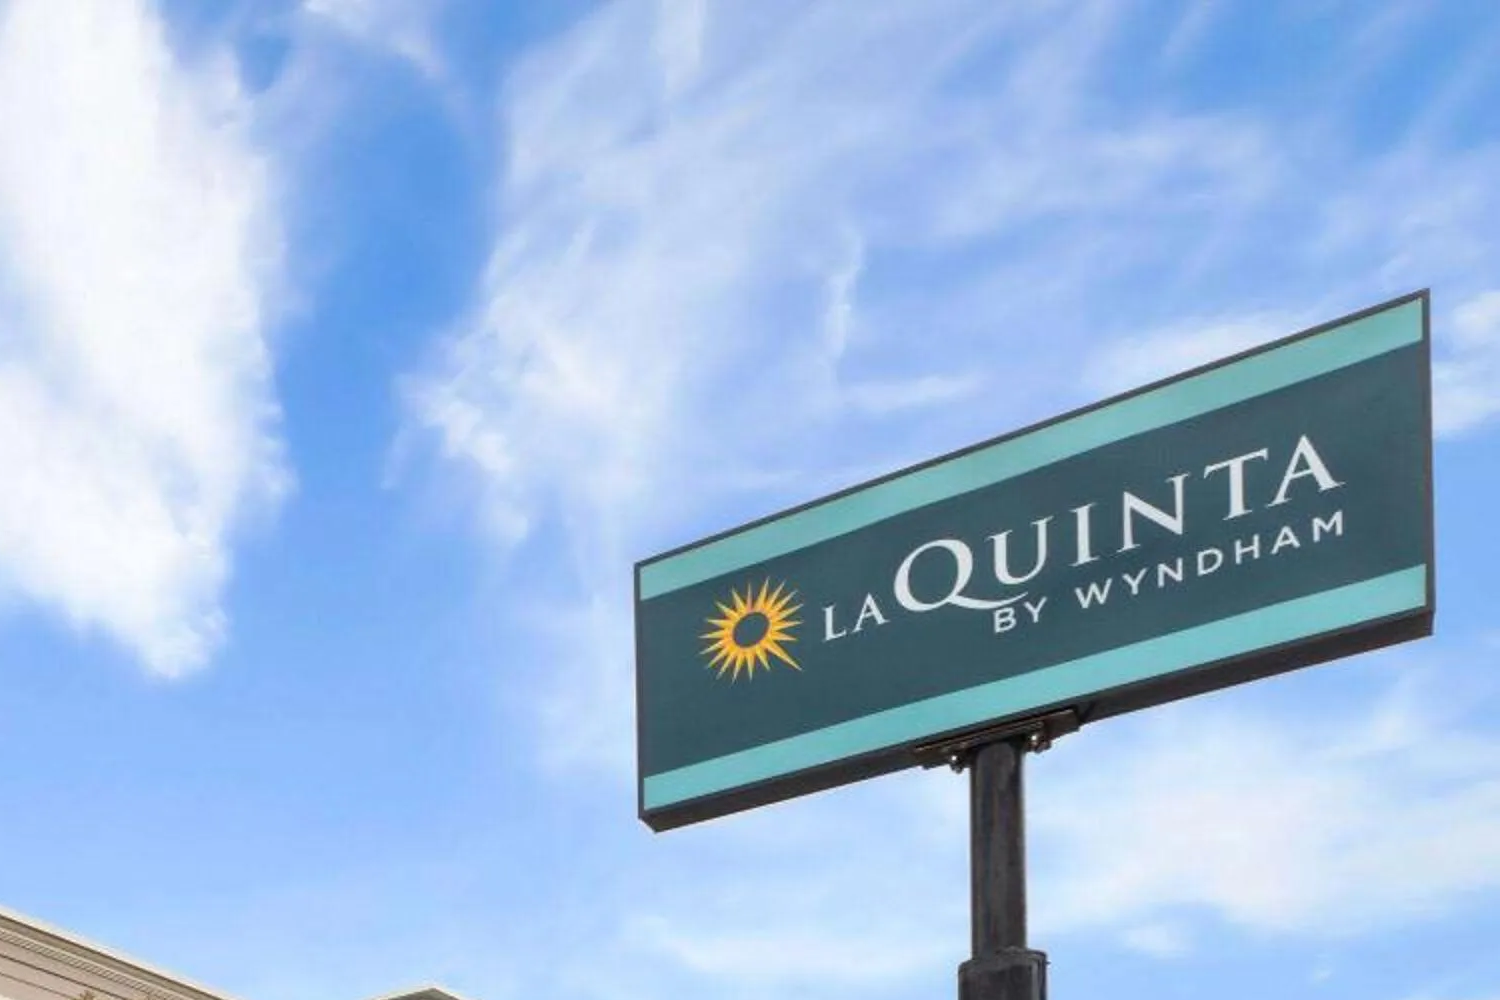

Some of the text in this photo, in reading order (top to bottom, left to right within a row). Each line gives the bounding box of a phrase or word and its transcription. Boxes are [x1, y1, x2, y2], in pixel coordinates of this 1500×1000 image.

[822, 434, 1347, 642] LA QUINTA
[993, 510, 1344, 634] BY WYNDHAM
